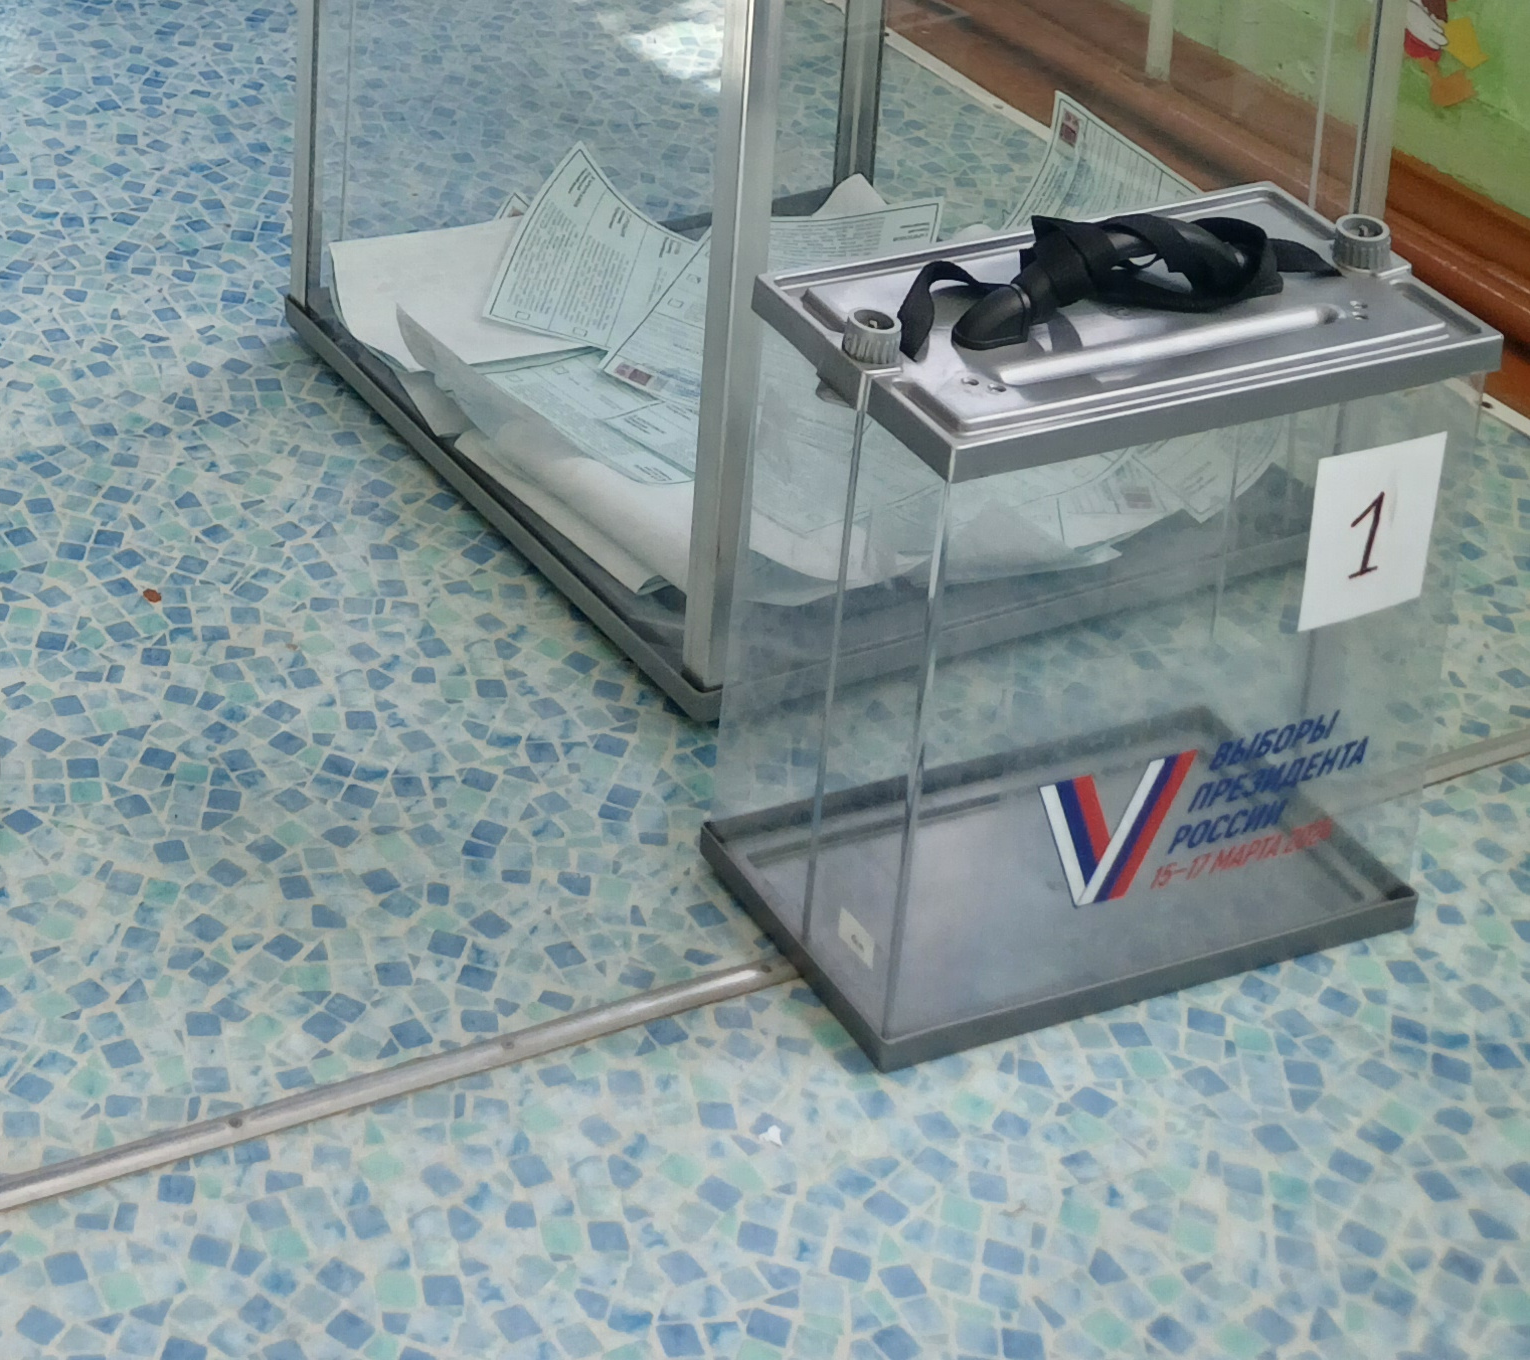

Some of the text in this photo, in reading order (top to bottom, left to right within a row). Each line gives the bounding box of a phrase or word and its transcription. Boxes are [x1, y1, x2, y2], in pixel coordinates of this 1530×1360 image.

[1348, 490, 1386, 580] 1
[1208, 709, 1342, 772] ВЫБОРЫ
[1186, 735, 1369, 814] ПРЕЗИДЕНТА
[1167, 798, 1288, 855] РОССИИ
[1208, 833, 1284, 875] МАРТА
